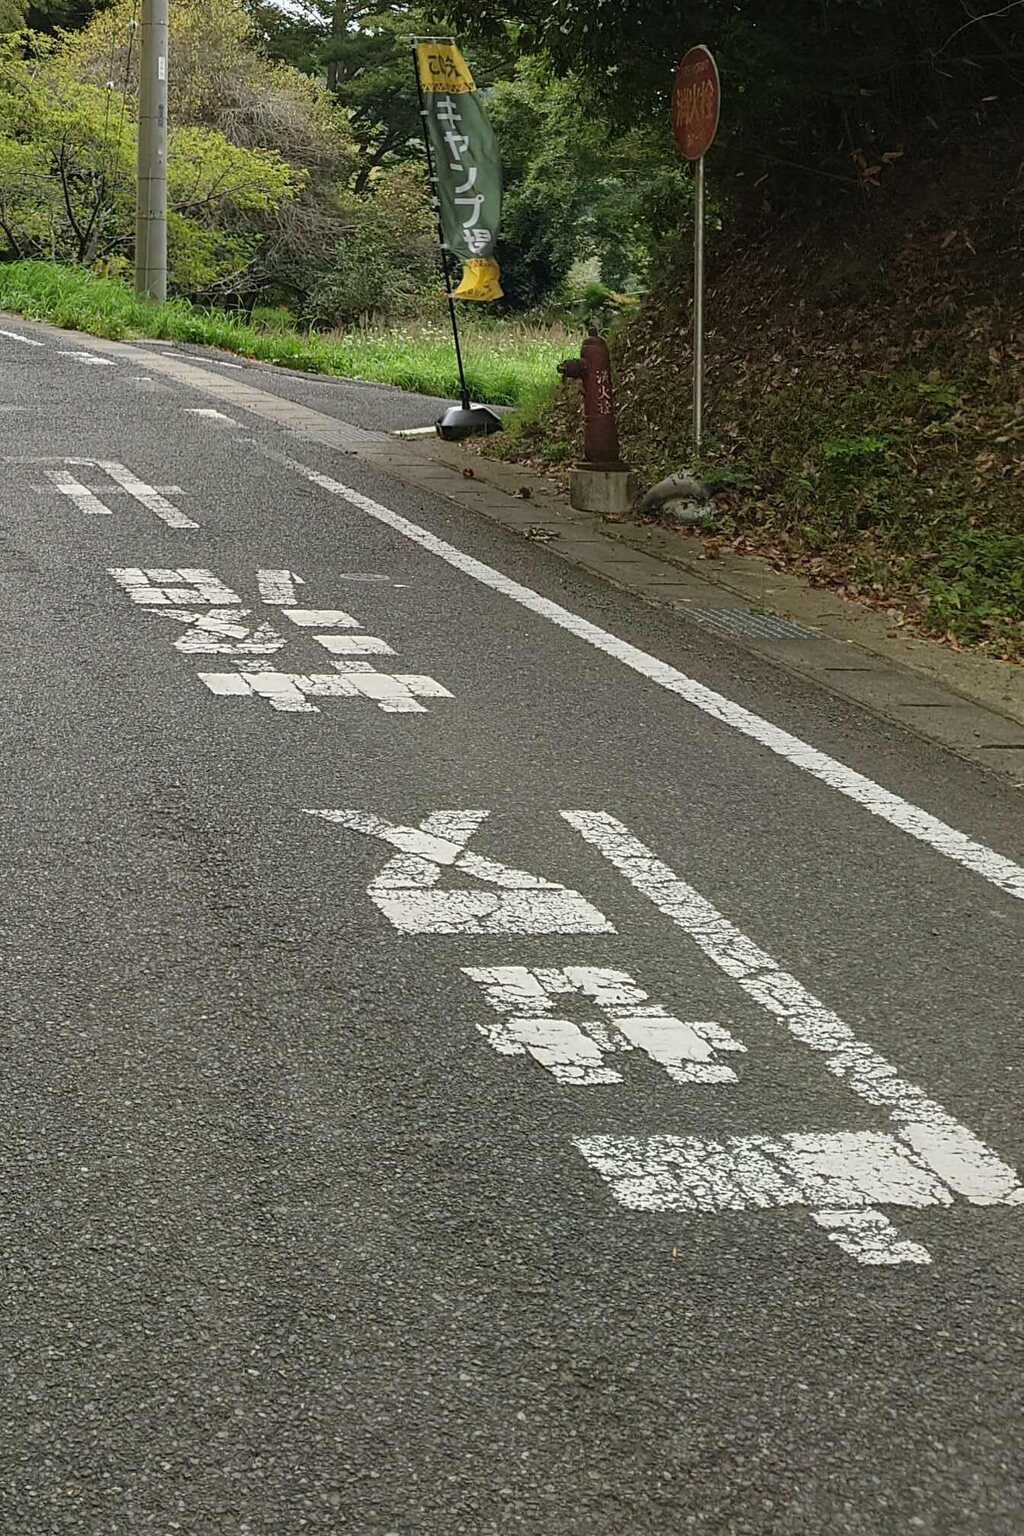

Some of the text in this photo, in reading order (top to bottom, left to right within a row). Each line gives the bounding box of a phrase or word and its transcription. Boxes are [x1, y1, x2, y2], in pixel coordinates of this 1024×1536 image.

[436, 96, 491, 255] キャンプ場
